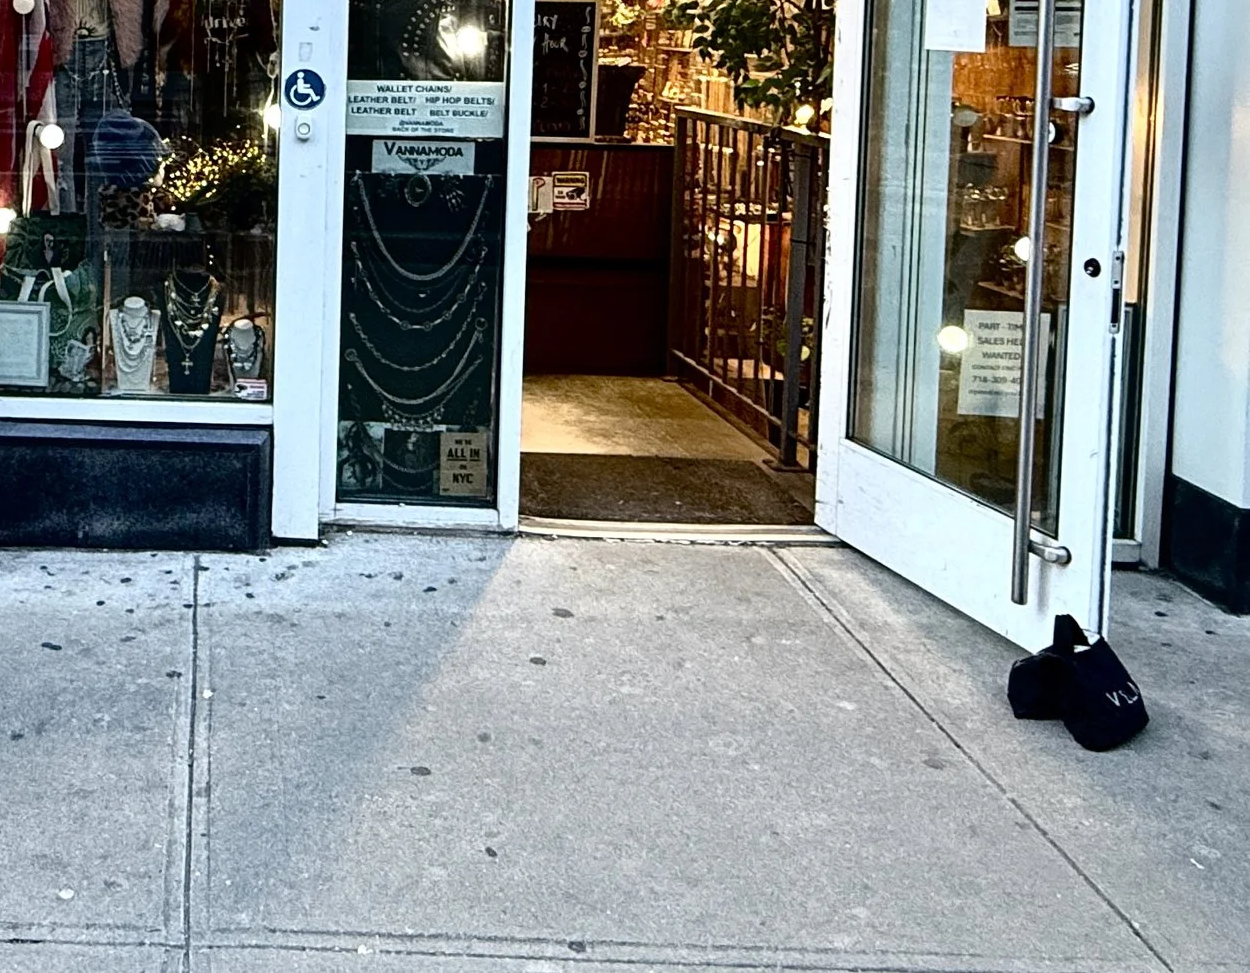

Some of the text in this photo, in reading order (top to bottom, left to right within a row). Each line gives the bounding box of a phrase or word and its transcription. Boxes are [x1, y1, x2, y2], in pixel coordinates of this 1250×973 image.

[377, 85, 413, 93] WALLET
[348, 96, 388, 104] LEATHER
[425, 97, 440, 105] HIP
[442, 97, 461, 105] HOP
[351, 107, 391, 115] LEATHER
[394, 108, 417, 116] BELT
[384, 141, 463, 157] VANNAMODA
[978, 322, 1000, 330] PART
[978, 337, 1005, 345] SALES
[982, 352, 1021, 360] WANTED
[447, 448, 480, 458] ALL IN
[452, 473, 474, 484] NYC
